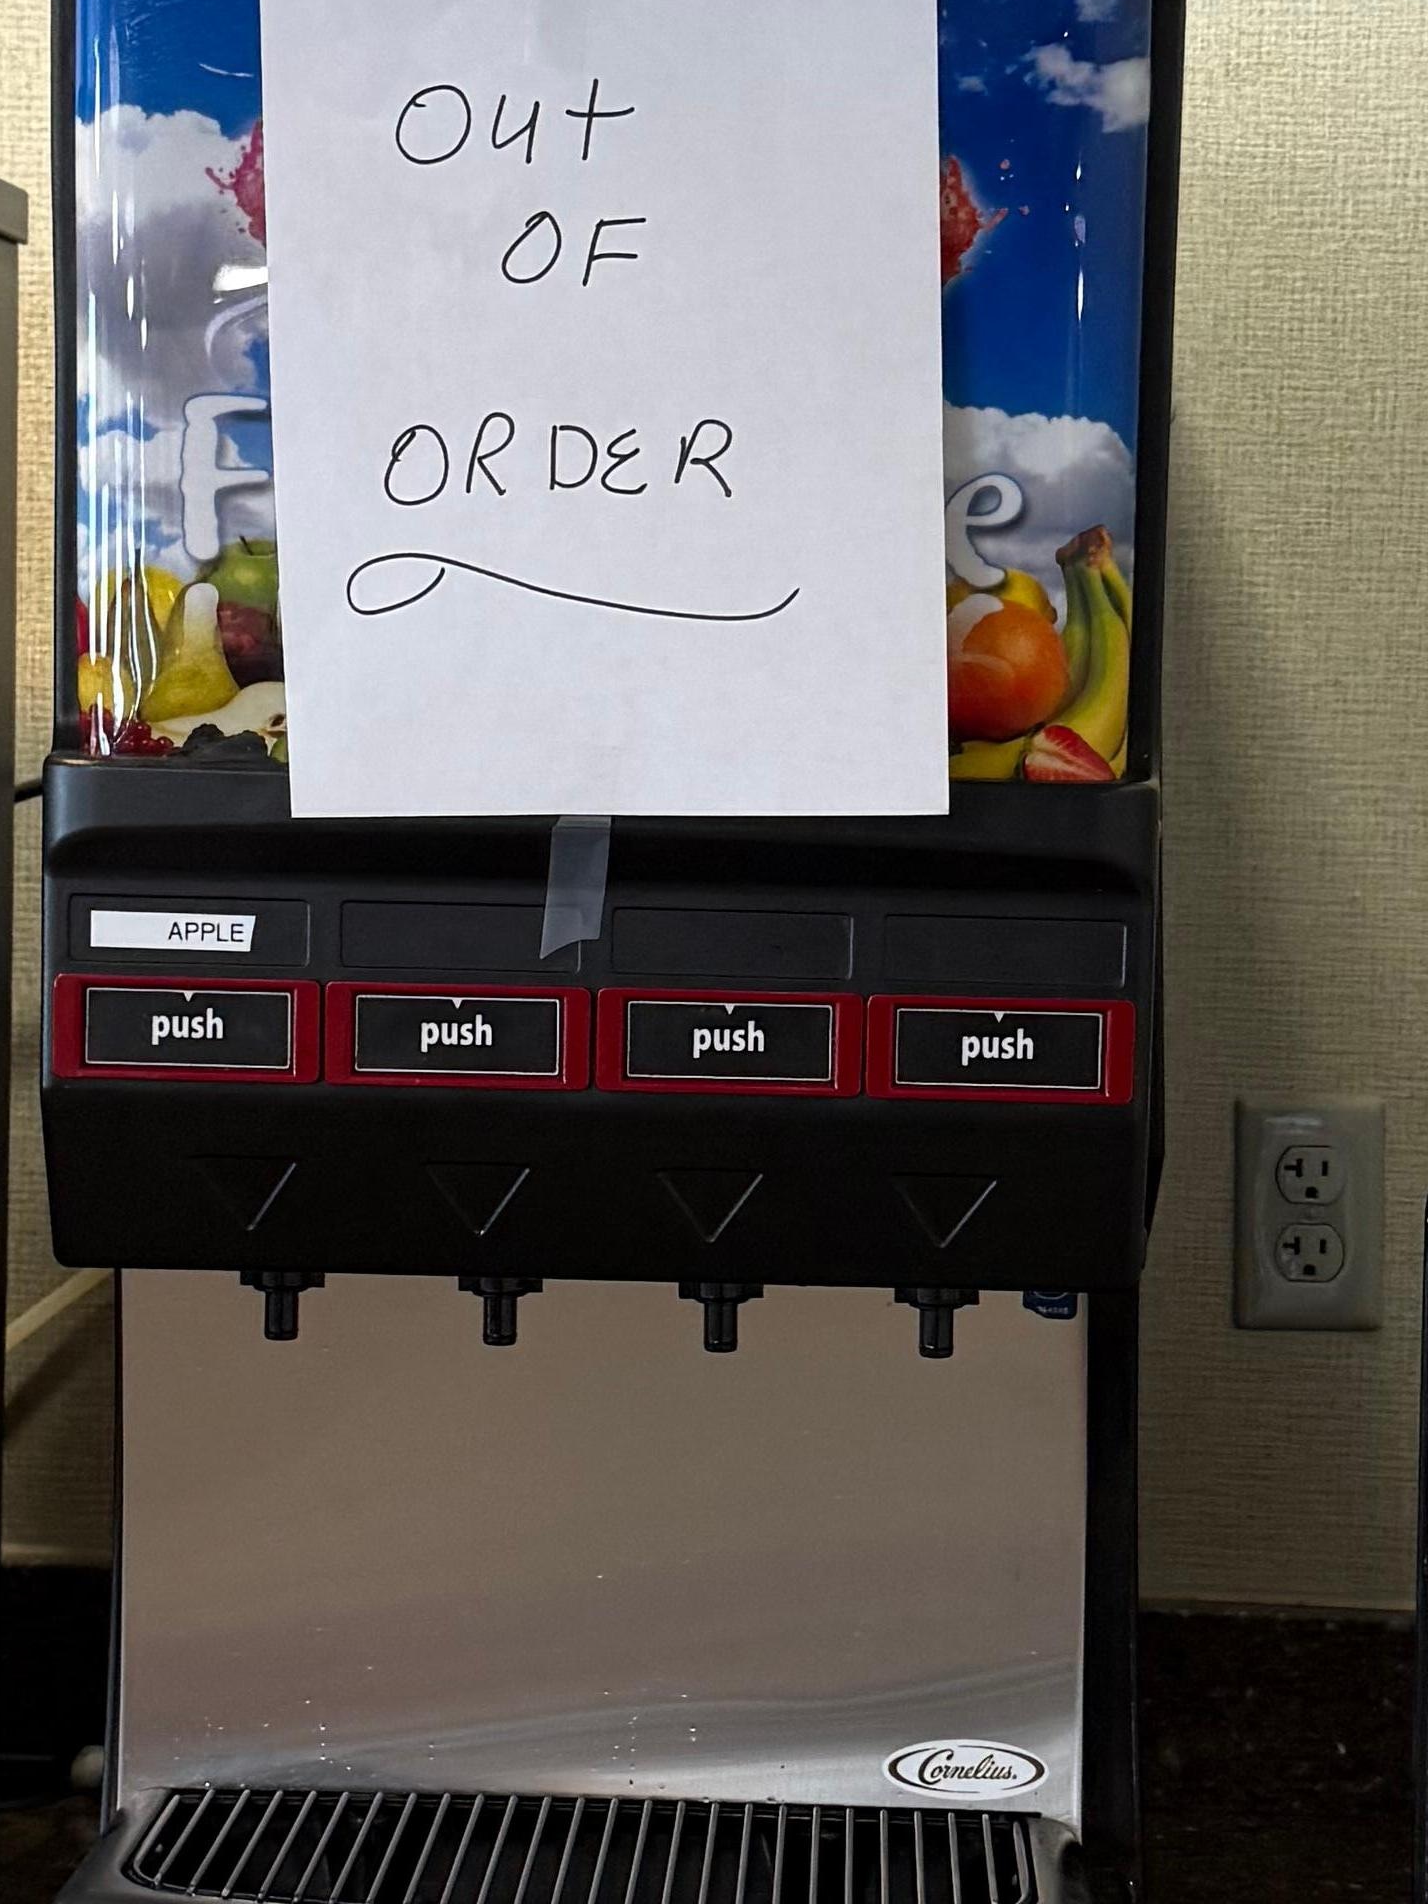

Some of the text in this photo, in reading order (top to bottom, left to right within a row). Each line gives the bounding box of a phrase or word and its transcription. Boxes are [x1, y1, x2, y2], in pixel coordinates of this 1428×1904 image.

[501, 210, 647, 287] OF
[383, 411, 733, 506] ORDER
[167, 921, 245, 943] APPLE
[151, 1007, 224, 1046] push
[420, 1014, 493, 1053] push
[693, 1020, 765, 1059] push
[961, 1028, 1034, 1067] push
[918, 1749, 1014, 1785] Cornelius
